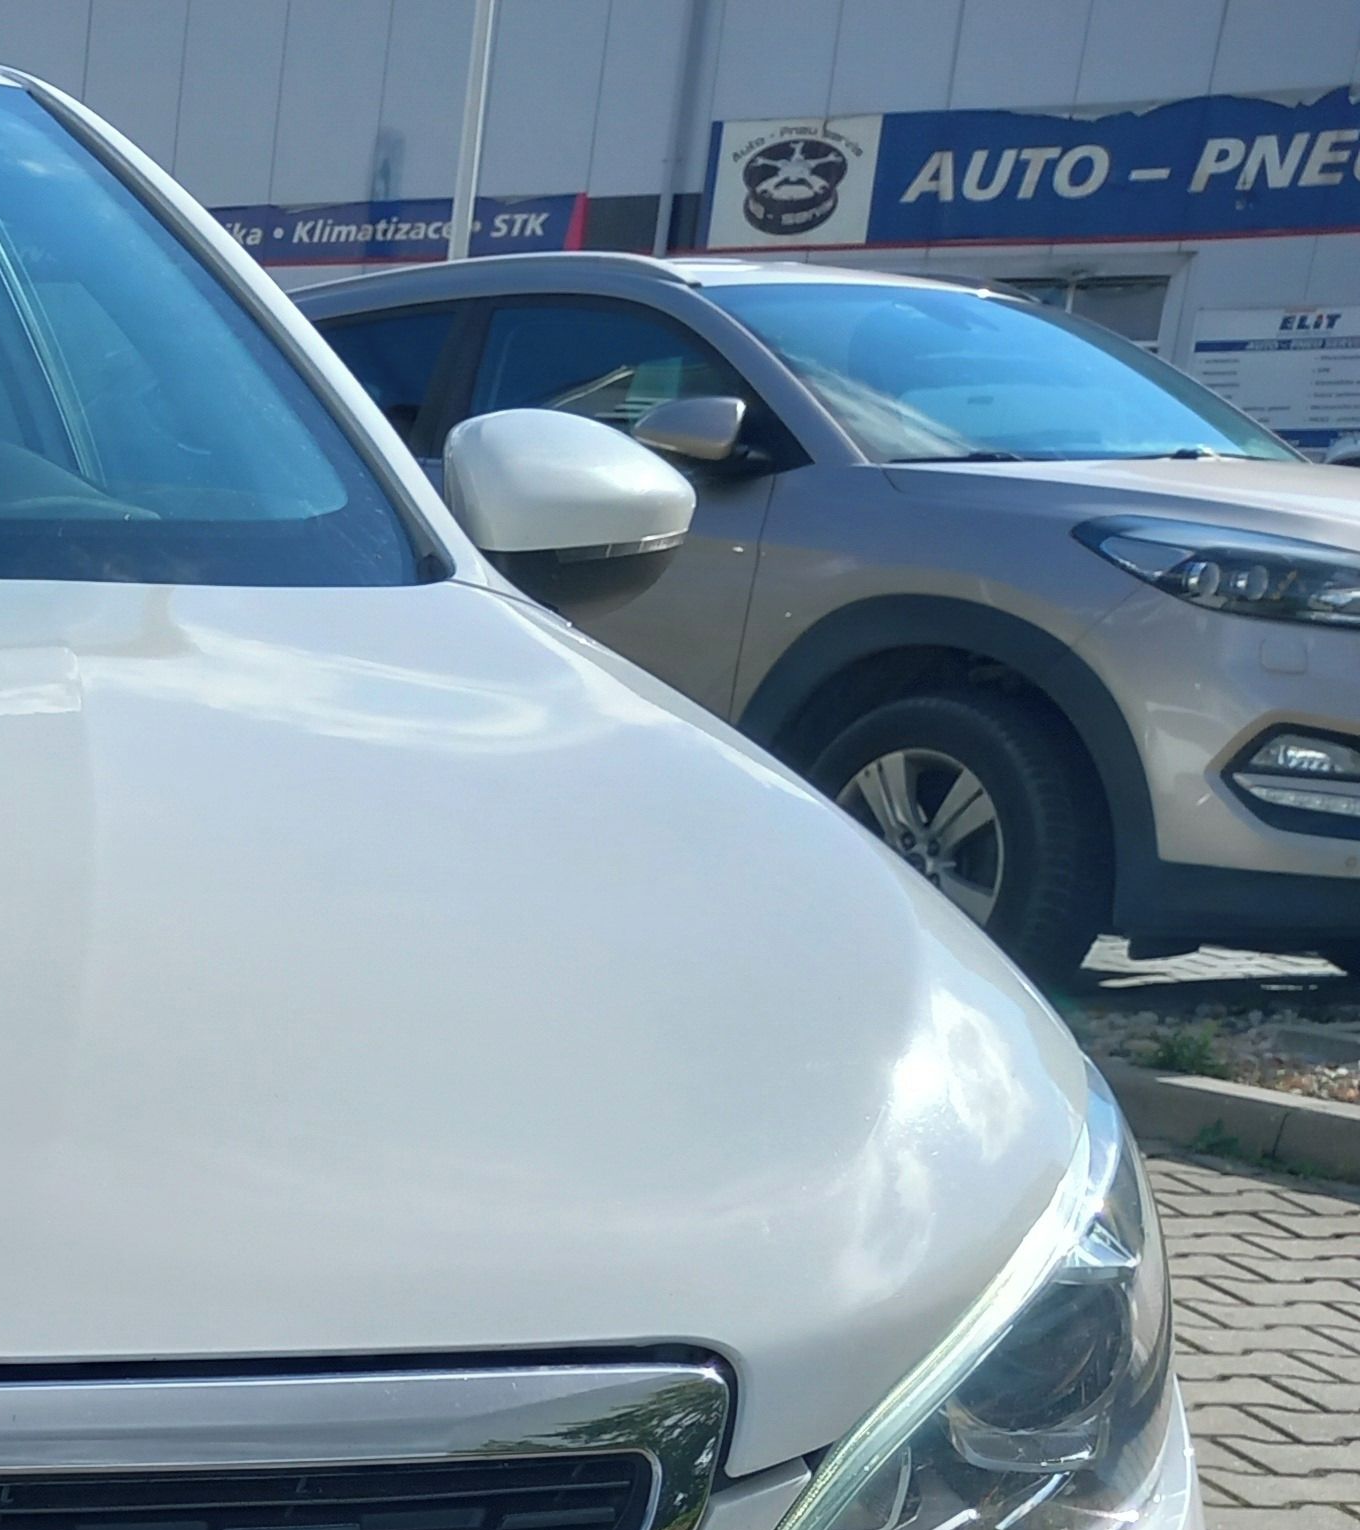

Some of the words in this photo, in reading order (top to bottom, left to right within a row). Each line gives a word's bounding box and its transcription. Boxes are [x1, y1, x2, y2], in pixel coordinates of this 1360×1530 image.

[899, 144, 1110, 203] AUTO
[1187, 128, 1360, 193] PNE
[489, 212, 550, 239] STK
